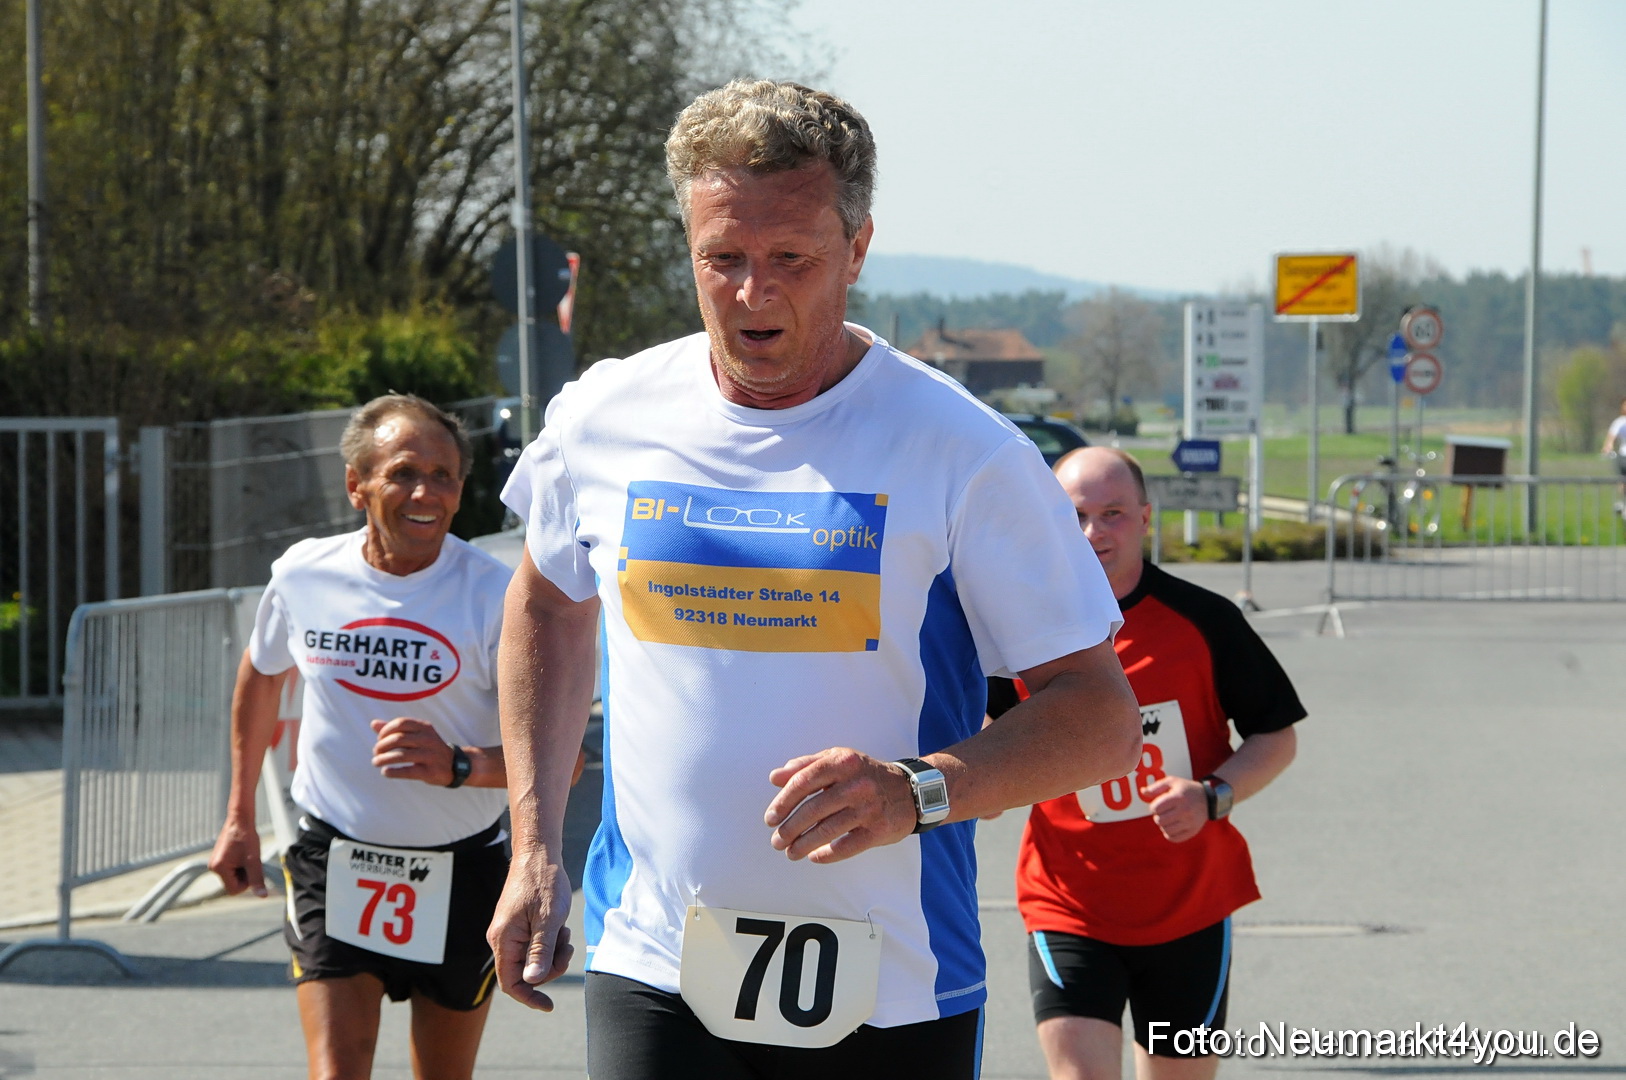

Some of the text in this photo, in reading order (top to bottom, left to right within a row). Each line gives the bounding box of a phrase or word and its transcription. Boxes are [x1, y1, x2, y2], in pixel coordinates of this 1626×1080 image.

[812, 526, 878, 552] optik
[647, 580, 841, 604] Ingolstädter Straße 14
[673, 607, 818, 628] 92318 Neumarkt
[304, 629, 441, 661] GERHART &
[350, 848, 405, 868] MEYER
[350, 861, 405, 879] WERBUNG
[356, 878, 417, 946] 73
[734, 916, 839, 1028] 70
